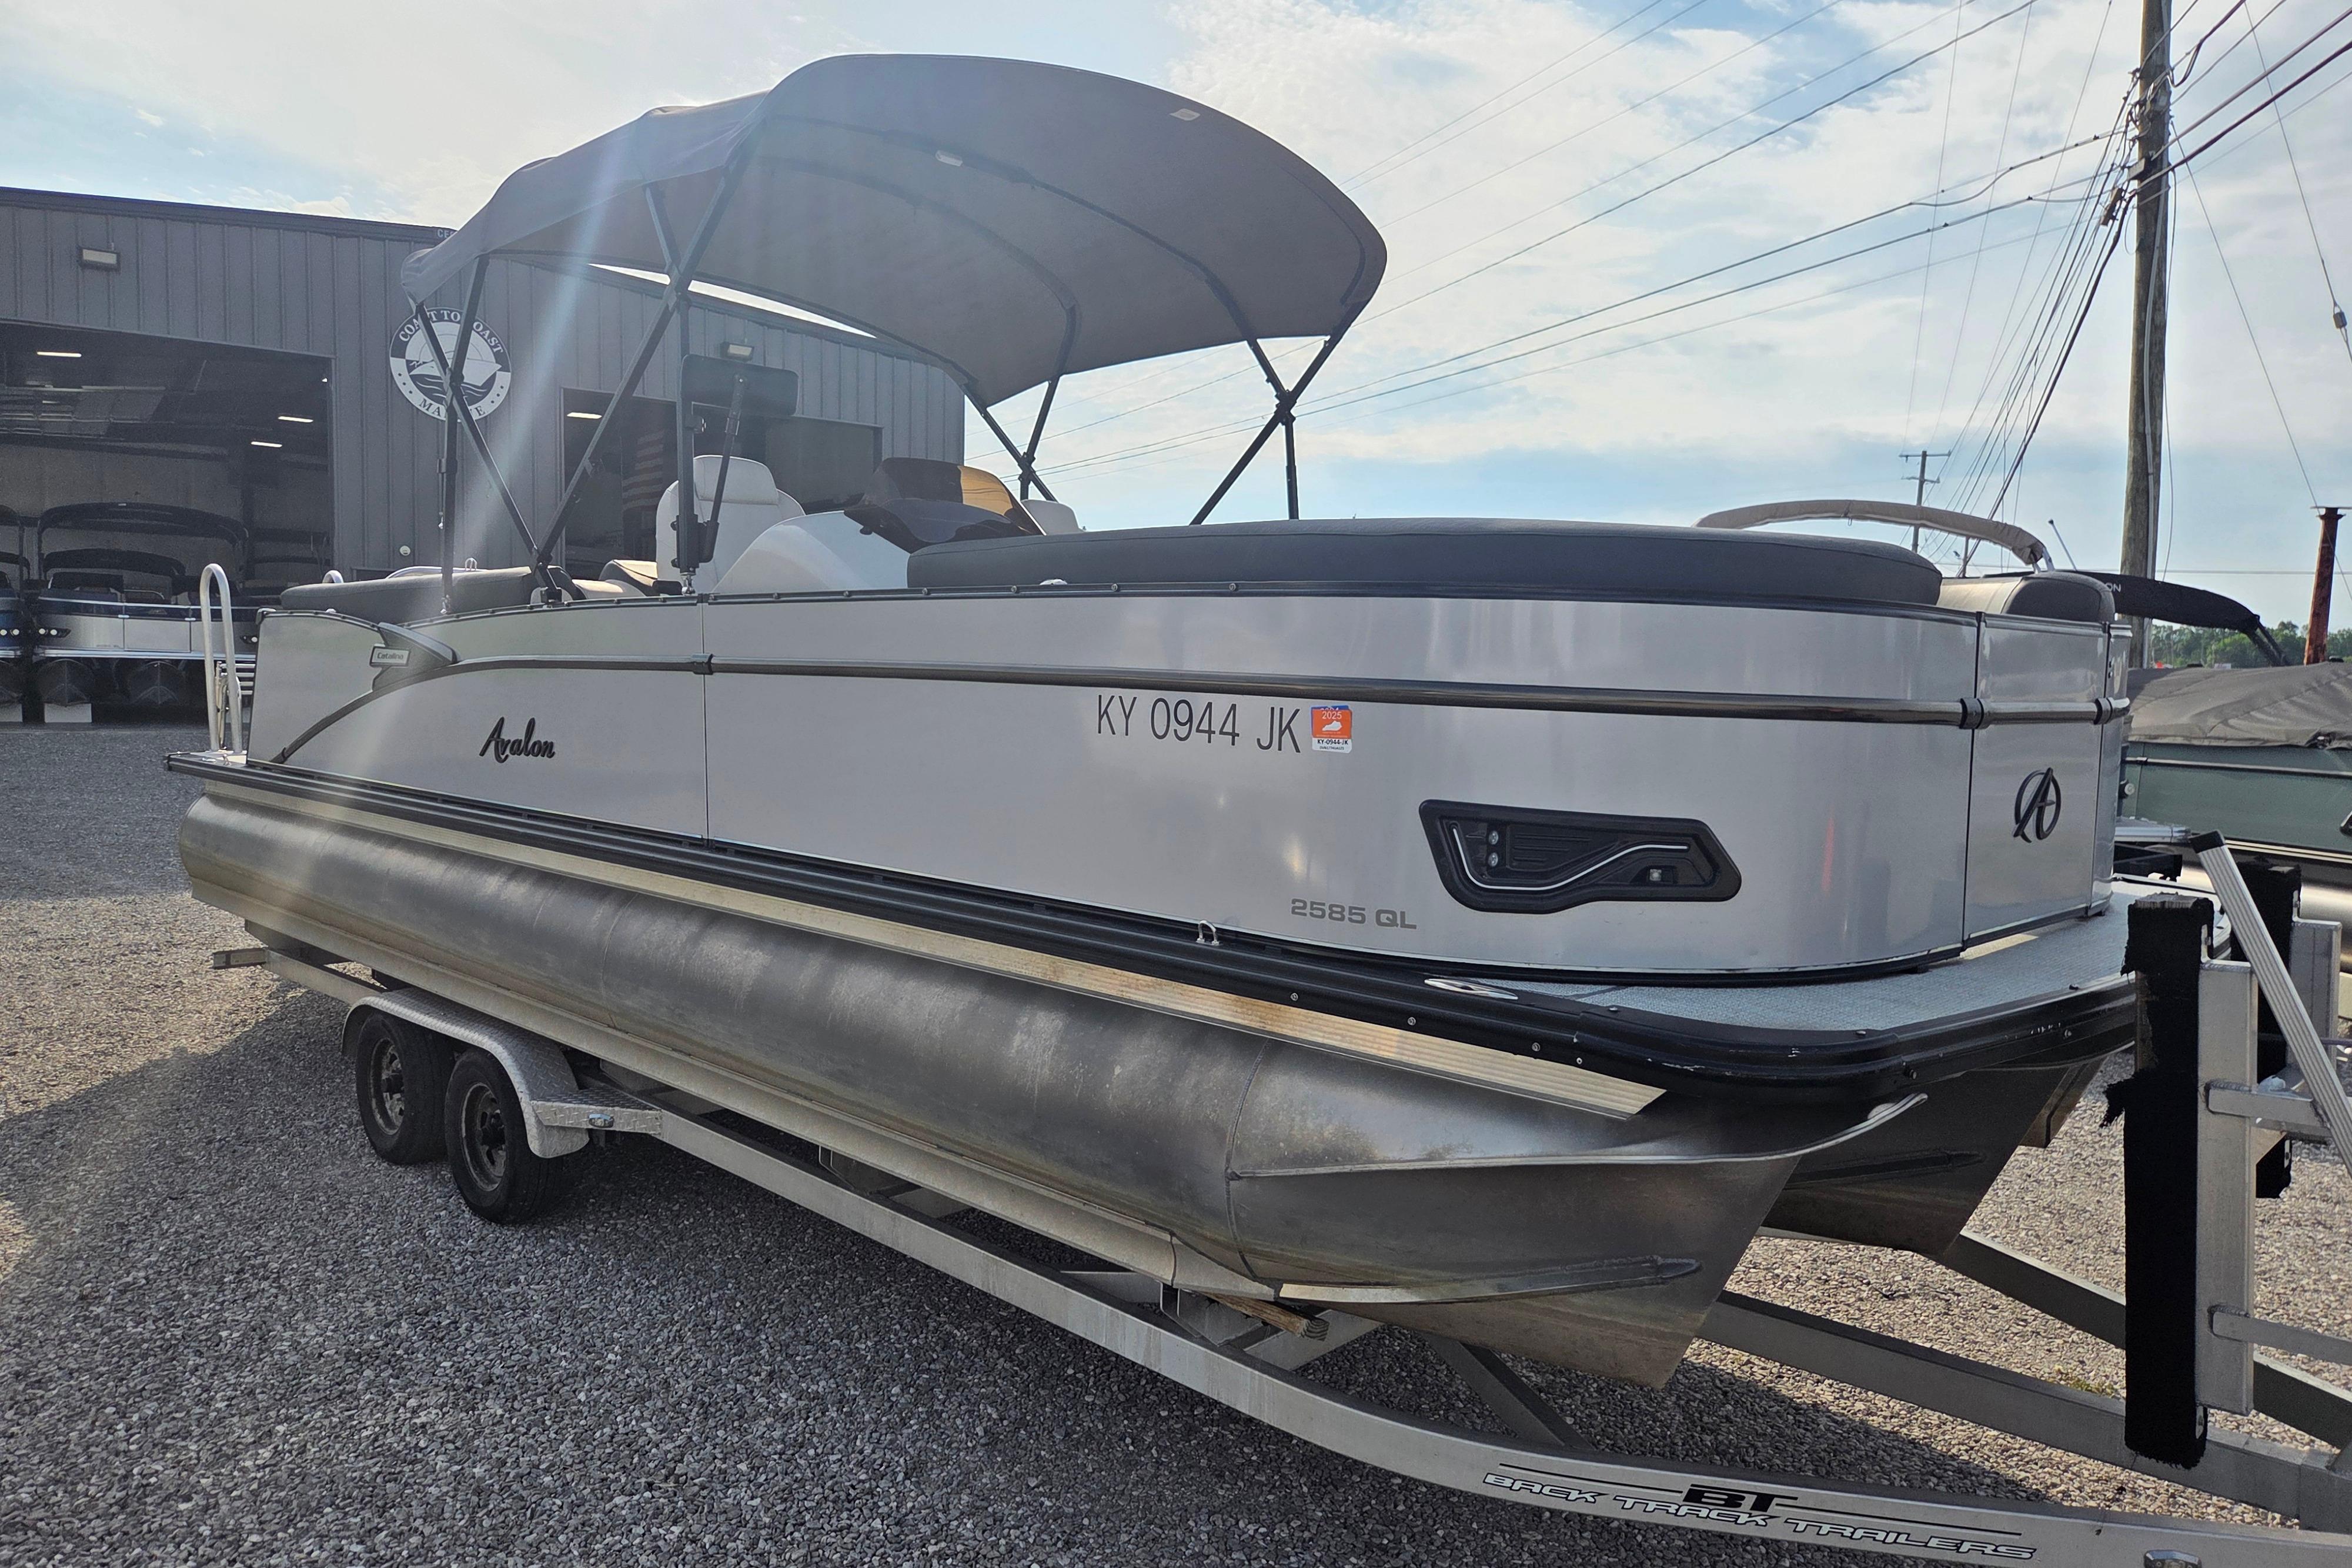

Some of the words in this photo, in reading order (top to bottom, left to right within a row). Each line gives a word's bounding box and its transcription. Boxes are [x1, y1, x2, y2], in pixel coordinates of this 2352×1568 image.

[399, 310, 437, 342] COAT
[440, 310, 461, 322] TO
[472, 321, 503, 353] OAST
[1097, 694, 1138, 737] KY
[1150, 697, 1240, 747] 0944
[1257, 706, 1301, 753] JK
[1322, 711, 1342, 720] 2025
[479, 716, 556, 764] Avalon
[1291, 898, 1367, 925] 2585
[1375, 909, 1417, 930] QL
[1483, 1473, 1608, 1503] BACK
[1613, 1495, 1780, 1527] TRACK
[1785, 1517, 2037, 1560] TRAILERS
[1682, 1484, 1798, 1513] BT
